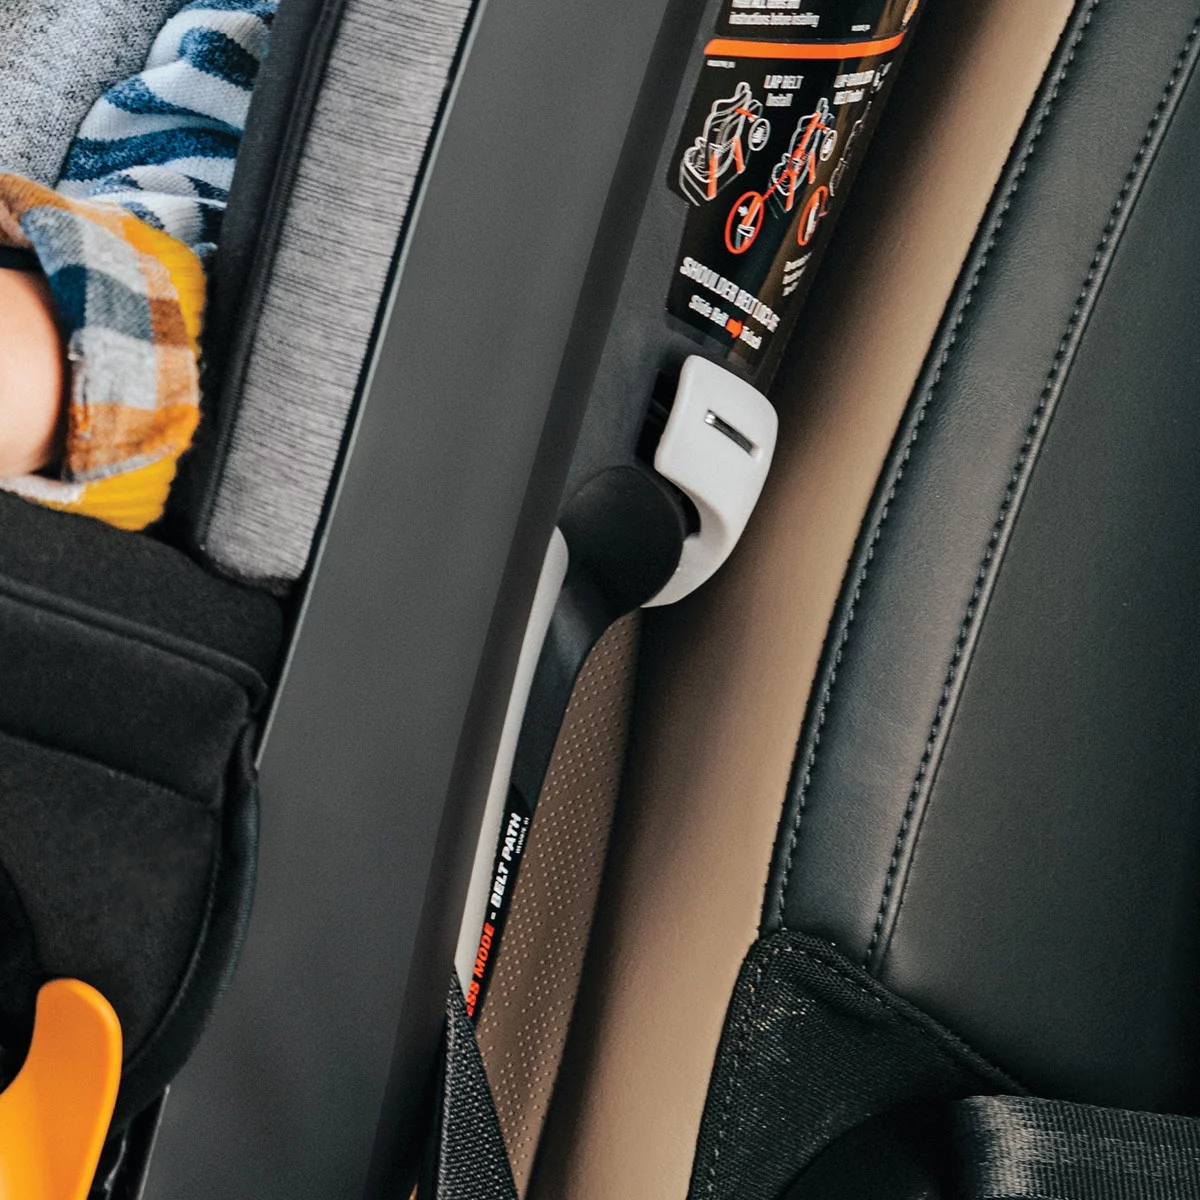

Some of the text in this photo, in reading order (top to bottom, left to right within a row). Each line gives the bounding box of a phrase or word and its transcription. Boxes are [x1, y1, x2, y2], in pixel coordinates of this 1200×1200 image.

[474, 922, 495, 979] MODE
[490, 861, 509, 908] BELT
[501, 812, 522, 861] PATH
